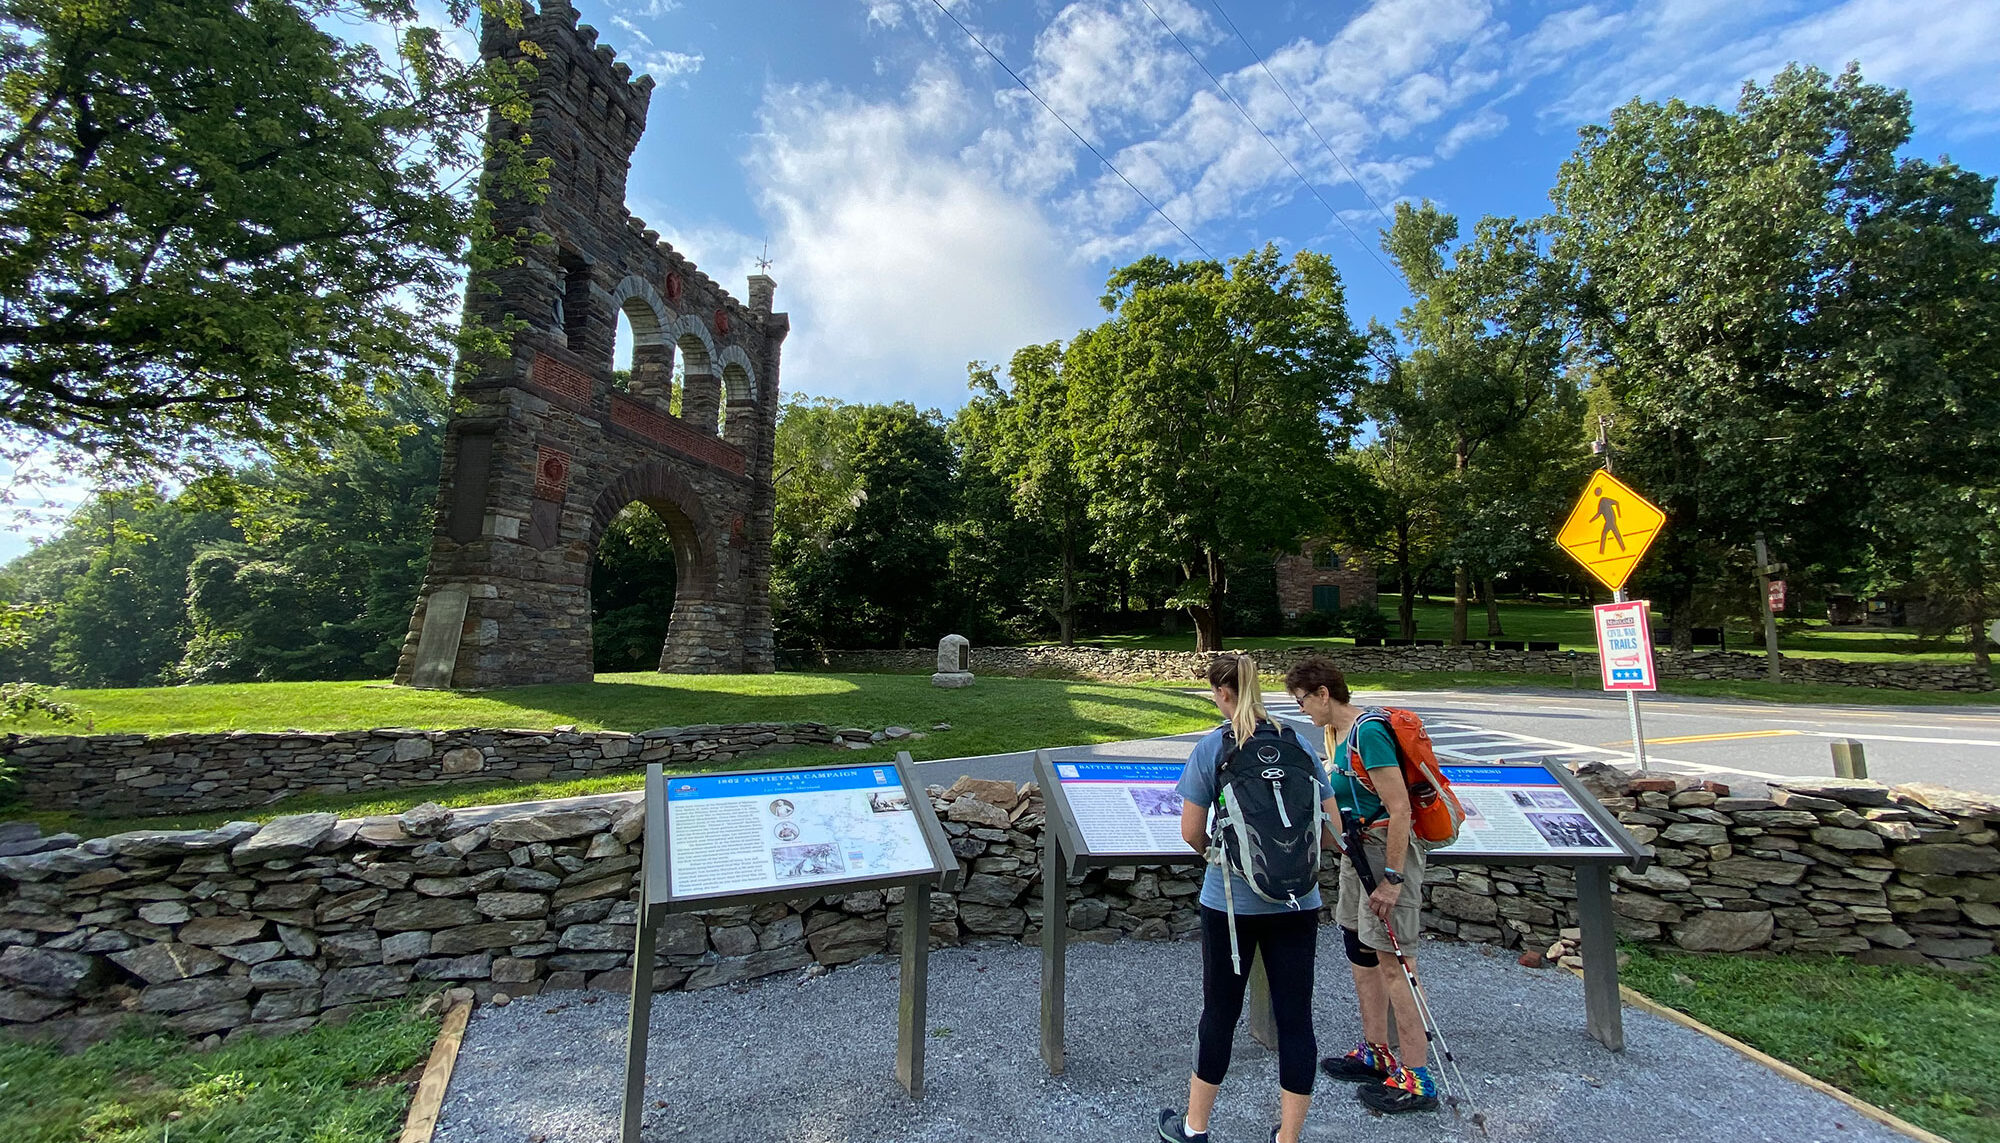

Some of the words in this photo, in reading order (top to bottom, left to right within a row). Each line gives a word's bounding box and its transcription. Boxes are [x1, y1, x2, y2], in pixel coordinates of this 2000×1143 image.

[1607, 629, 1623, 637] CIVIL
[1624, 628, 1636, 636] WAR
[1609, 638, 1637, 650] TRAILS
[744, 774, 800, 783] ANTIETAM
[804, 771, 858, 780] CAMPAIGN
